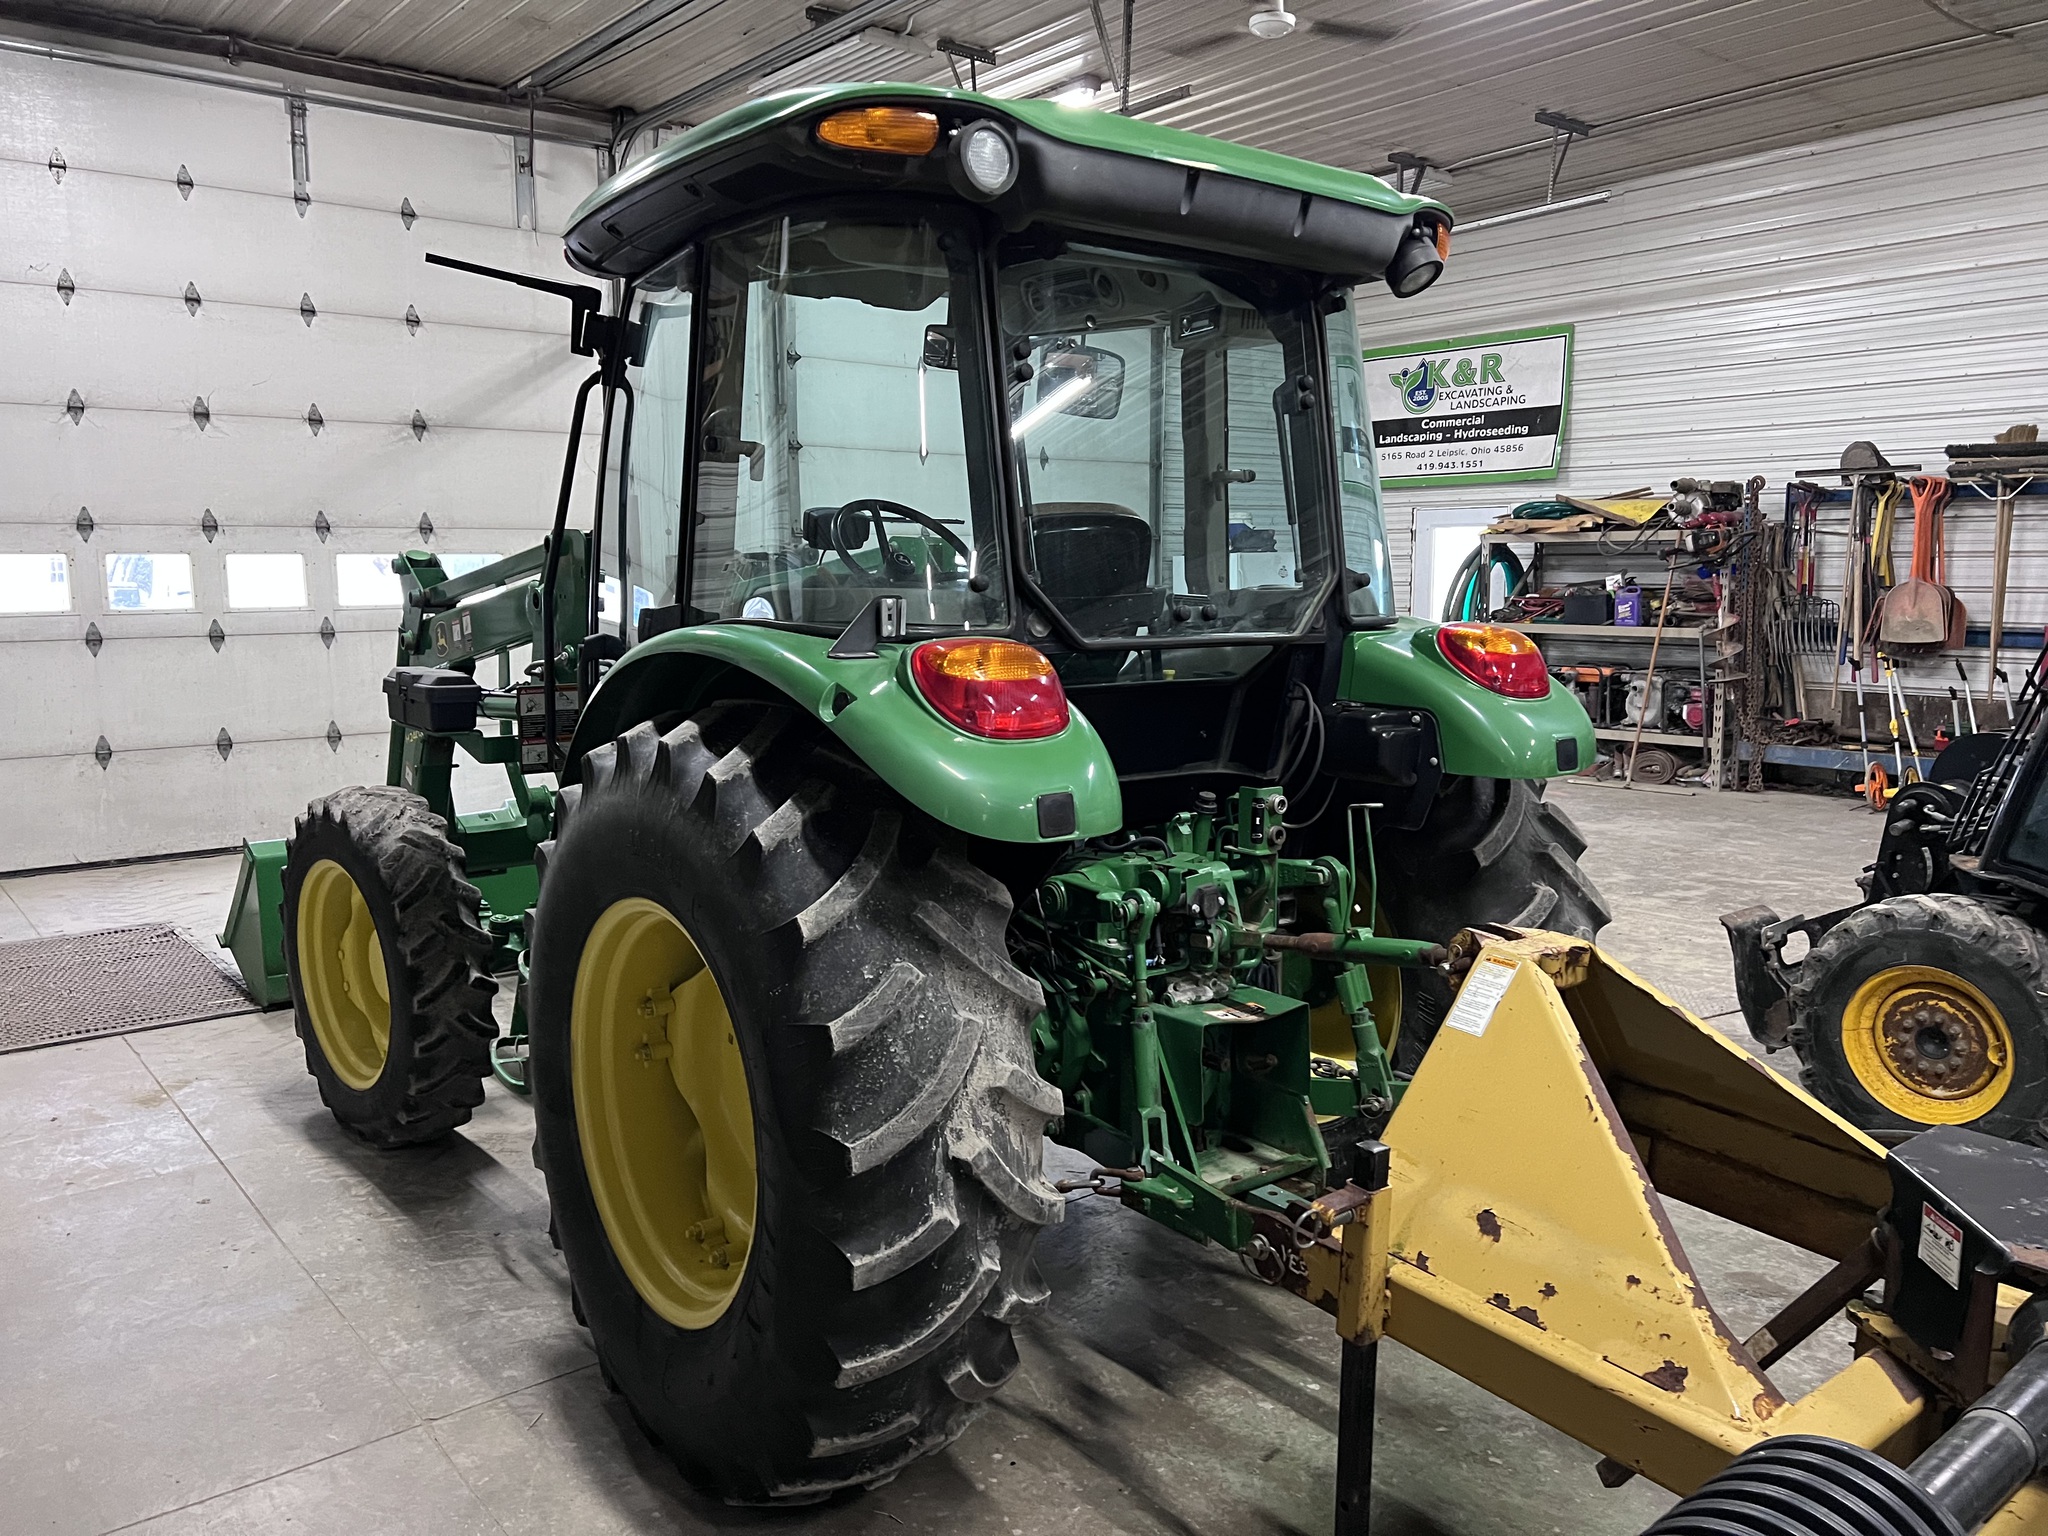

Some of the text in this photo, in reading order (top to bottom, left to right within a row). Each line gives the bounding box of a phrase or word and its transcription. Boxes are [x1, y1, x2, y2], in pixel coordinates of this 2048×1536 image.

[1439, 384, 1514, 401] EXCAVATING &
[1450, 394, 1527, 411] LANDSCAPING
[1421, 414, 1485, 429] Commercial
[1378, 430, 1443, 445] Landscaping
[1454, 424, 1529, 440] Hydroseeding
[1381, 452, 1403, 461] 5165
[1405, 450, 1426, 459] Road
[1428, 449, 1434, 458] 2
[1470, 445, 1491, 455] Ohio
[1494, 443, 1524, 454] 45856
[1416, 459, 1484, 471] 419.943.1551
